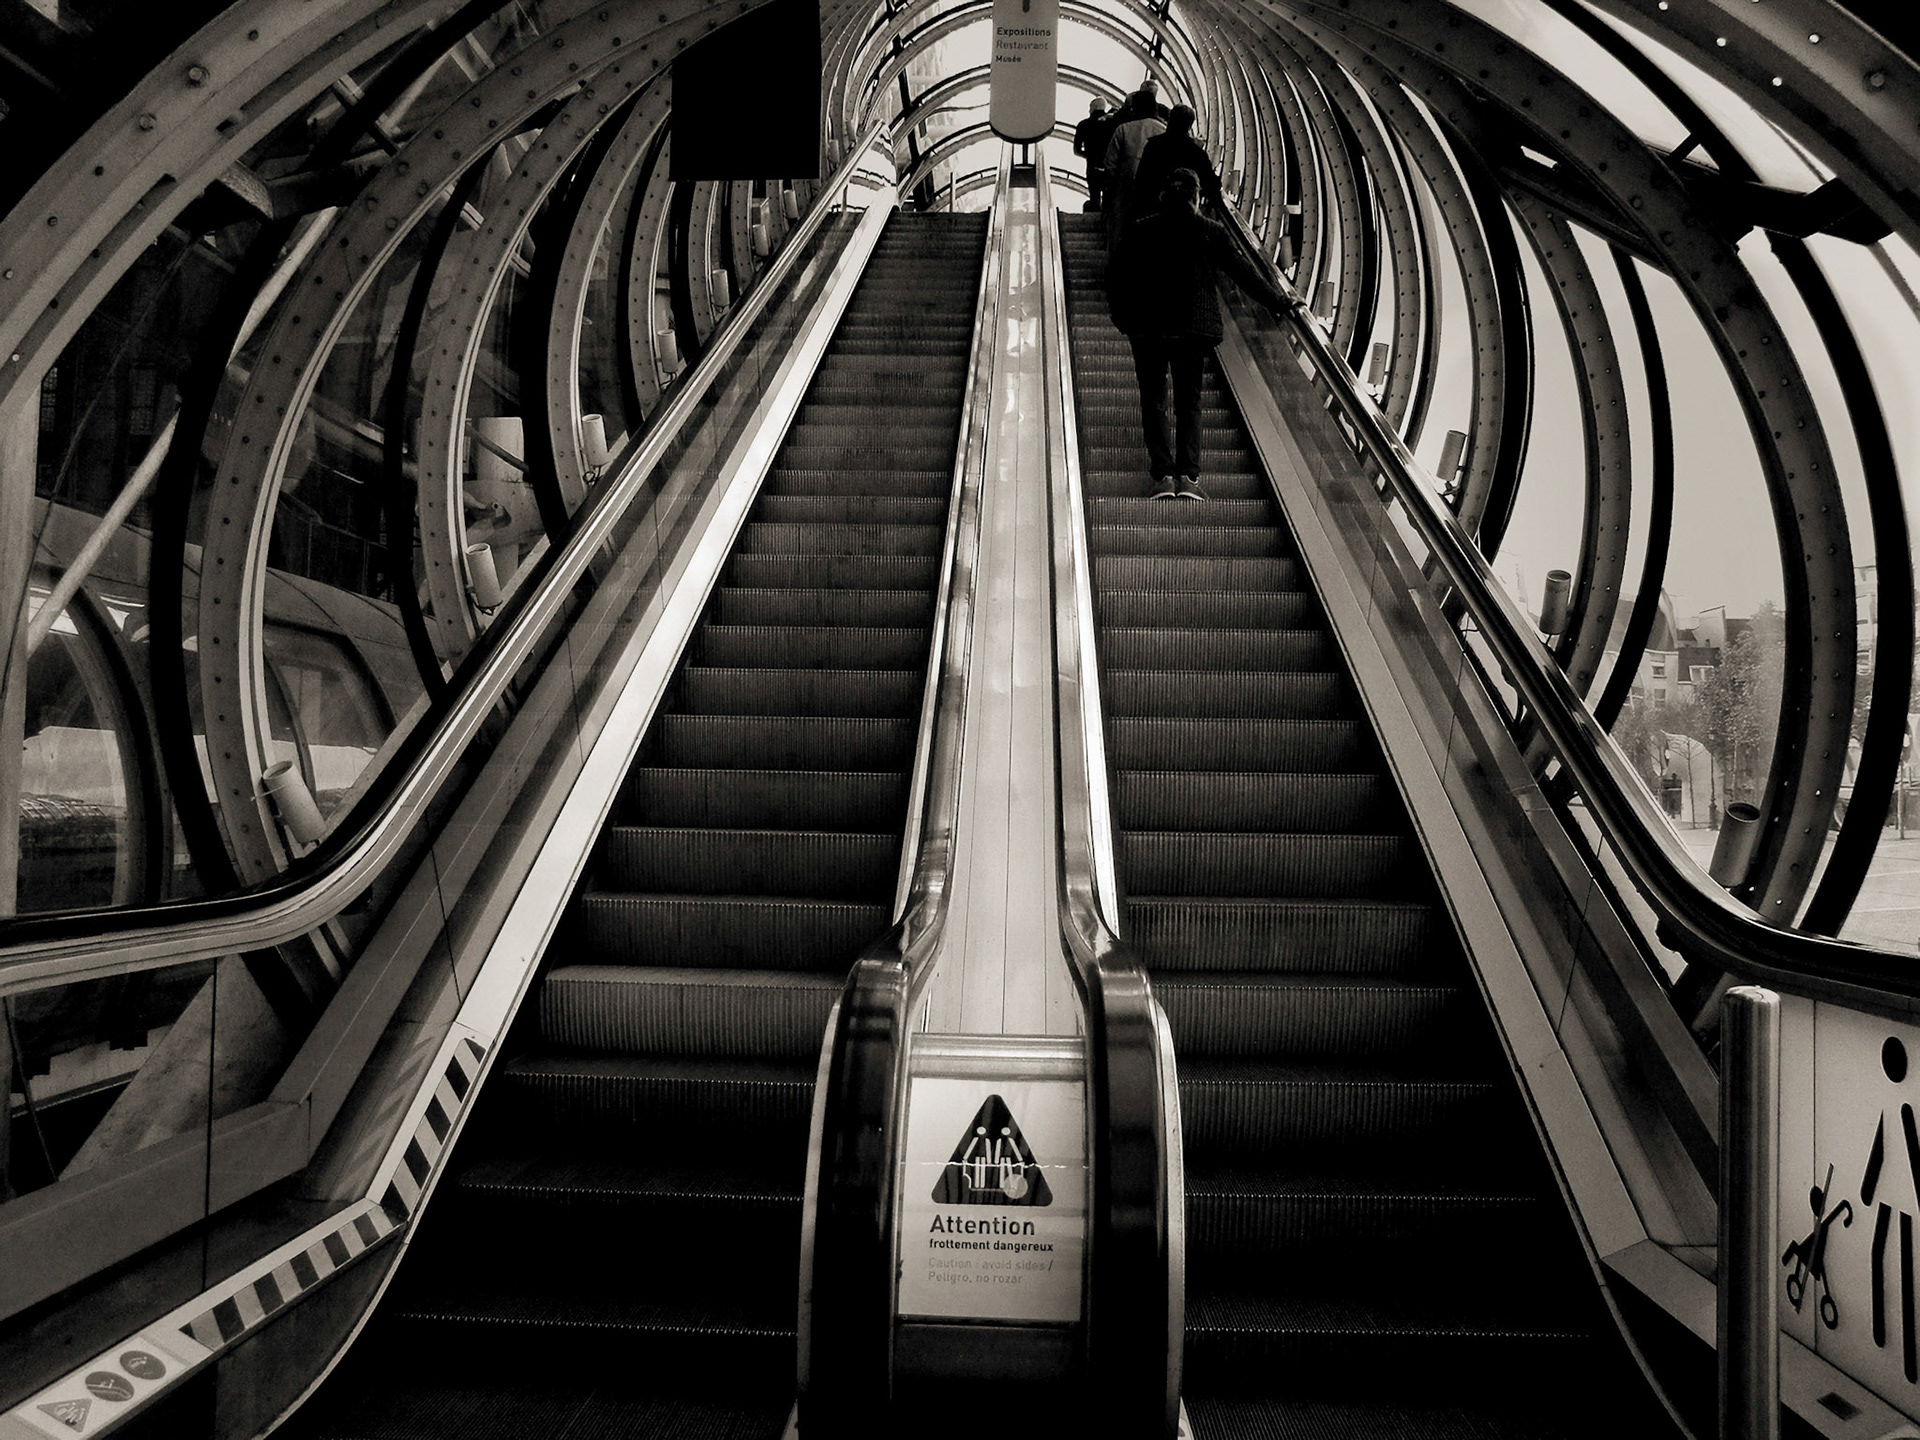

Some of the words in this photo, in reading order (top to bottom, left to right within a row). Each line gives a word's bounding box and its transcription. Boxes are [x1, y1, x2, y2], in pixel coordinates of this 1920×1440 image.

[997, 27, 1051, 36] Expositions
[929, 1214, 1035, 1235] Attention
[929, 1238, 990, 1251] frottement
[993, 1240, 1054, 1254] dangereux
[982, 1259, 1012, 1270] avoid
[928, 1271, 973, 1285] Peligro,
[975, 1274, 990, 1283] no
[993, 1274, 1023, 1285] rozar
